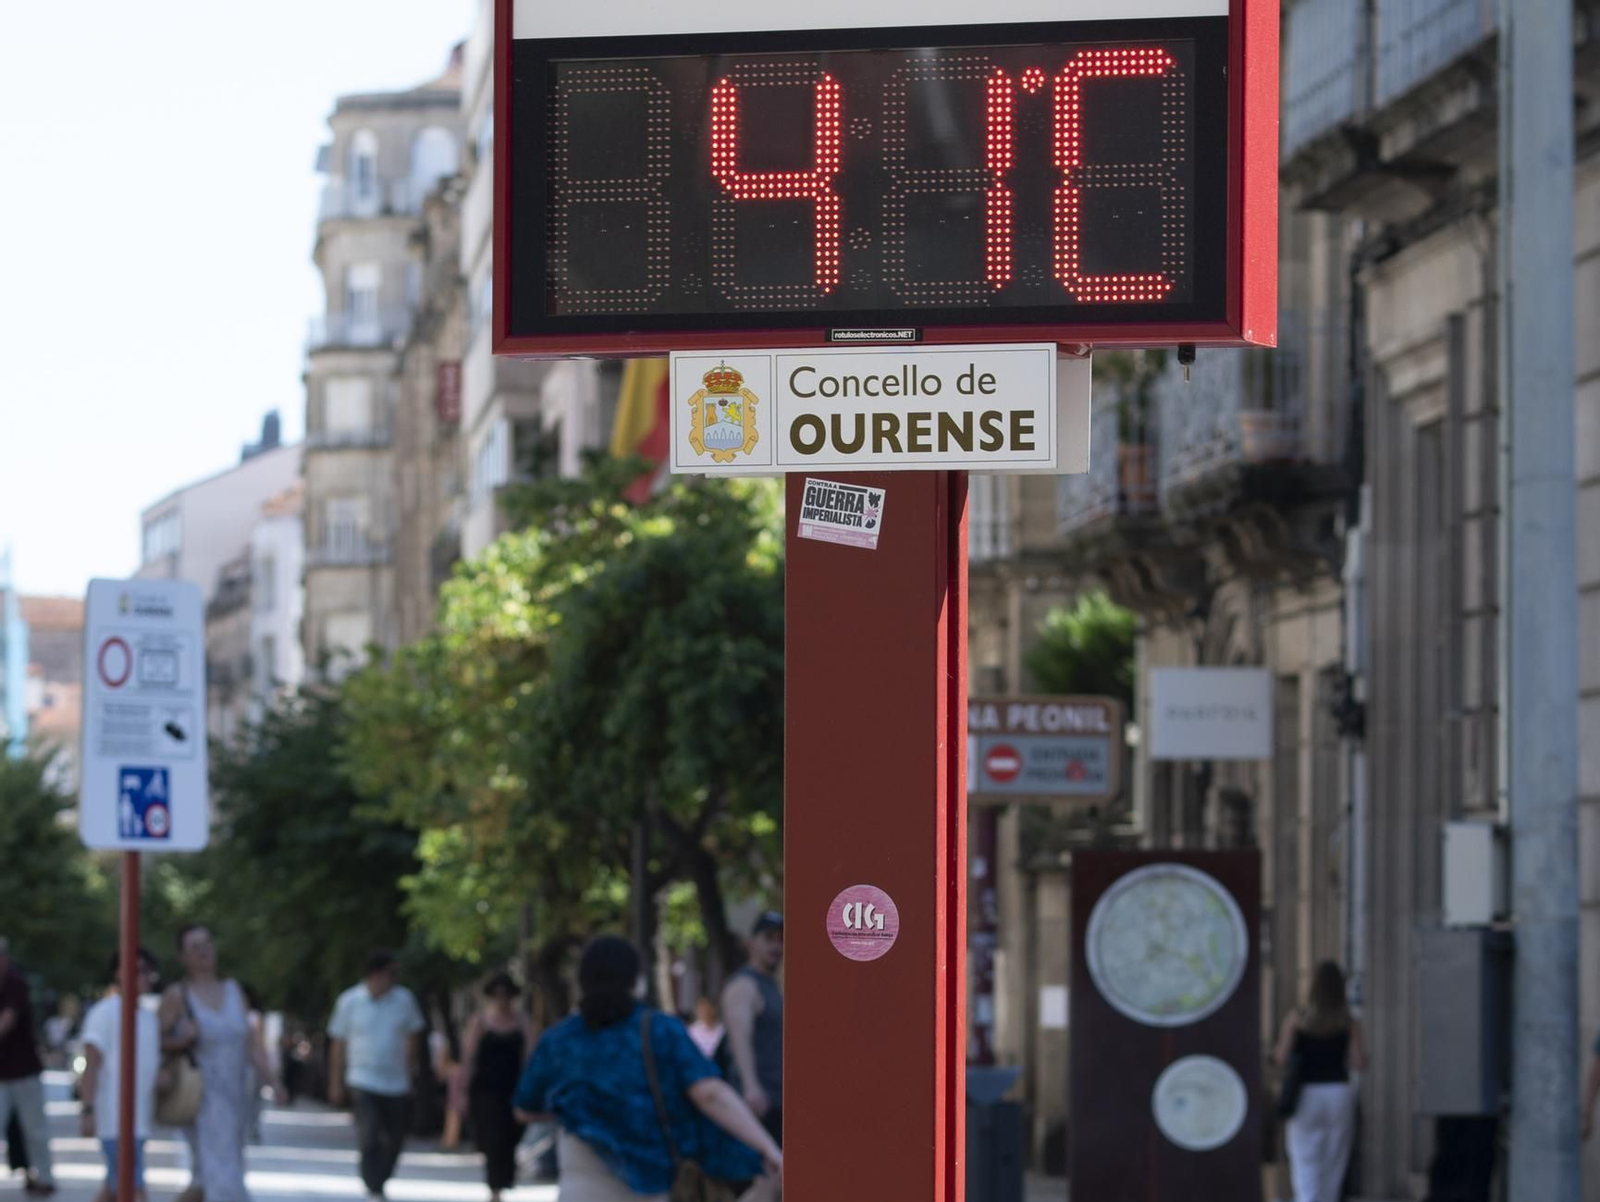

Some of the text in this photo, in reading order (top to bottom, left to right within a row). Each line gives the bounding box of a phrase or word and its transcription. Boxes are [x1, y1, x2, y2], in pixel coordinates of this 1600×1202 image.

[834, 331, 913, 339] rotuloselectronicos.NET
[789, 363, 996, 398] Concello de
[789, 410, 1036, 455] OURENSE
[807, 480, 832, 489] CONTRA
[804, 486, 865, 514] GUERRA
[802, 506, 863, 528] IMPERIALISTA
[842, 902, 885, 931] CIG
